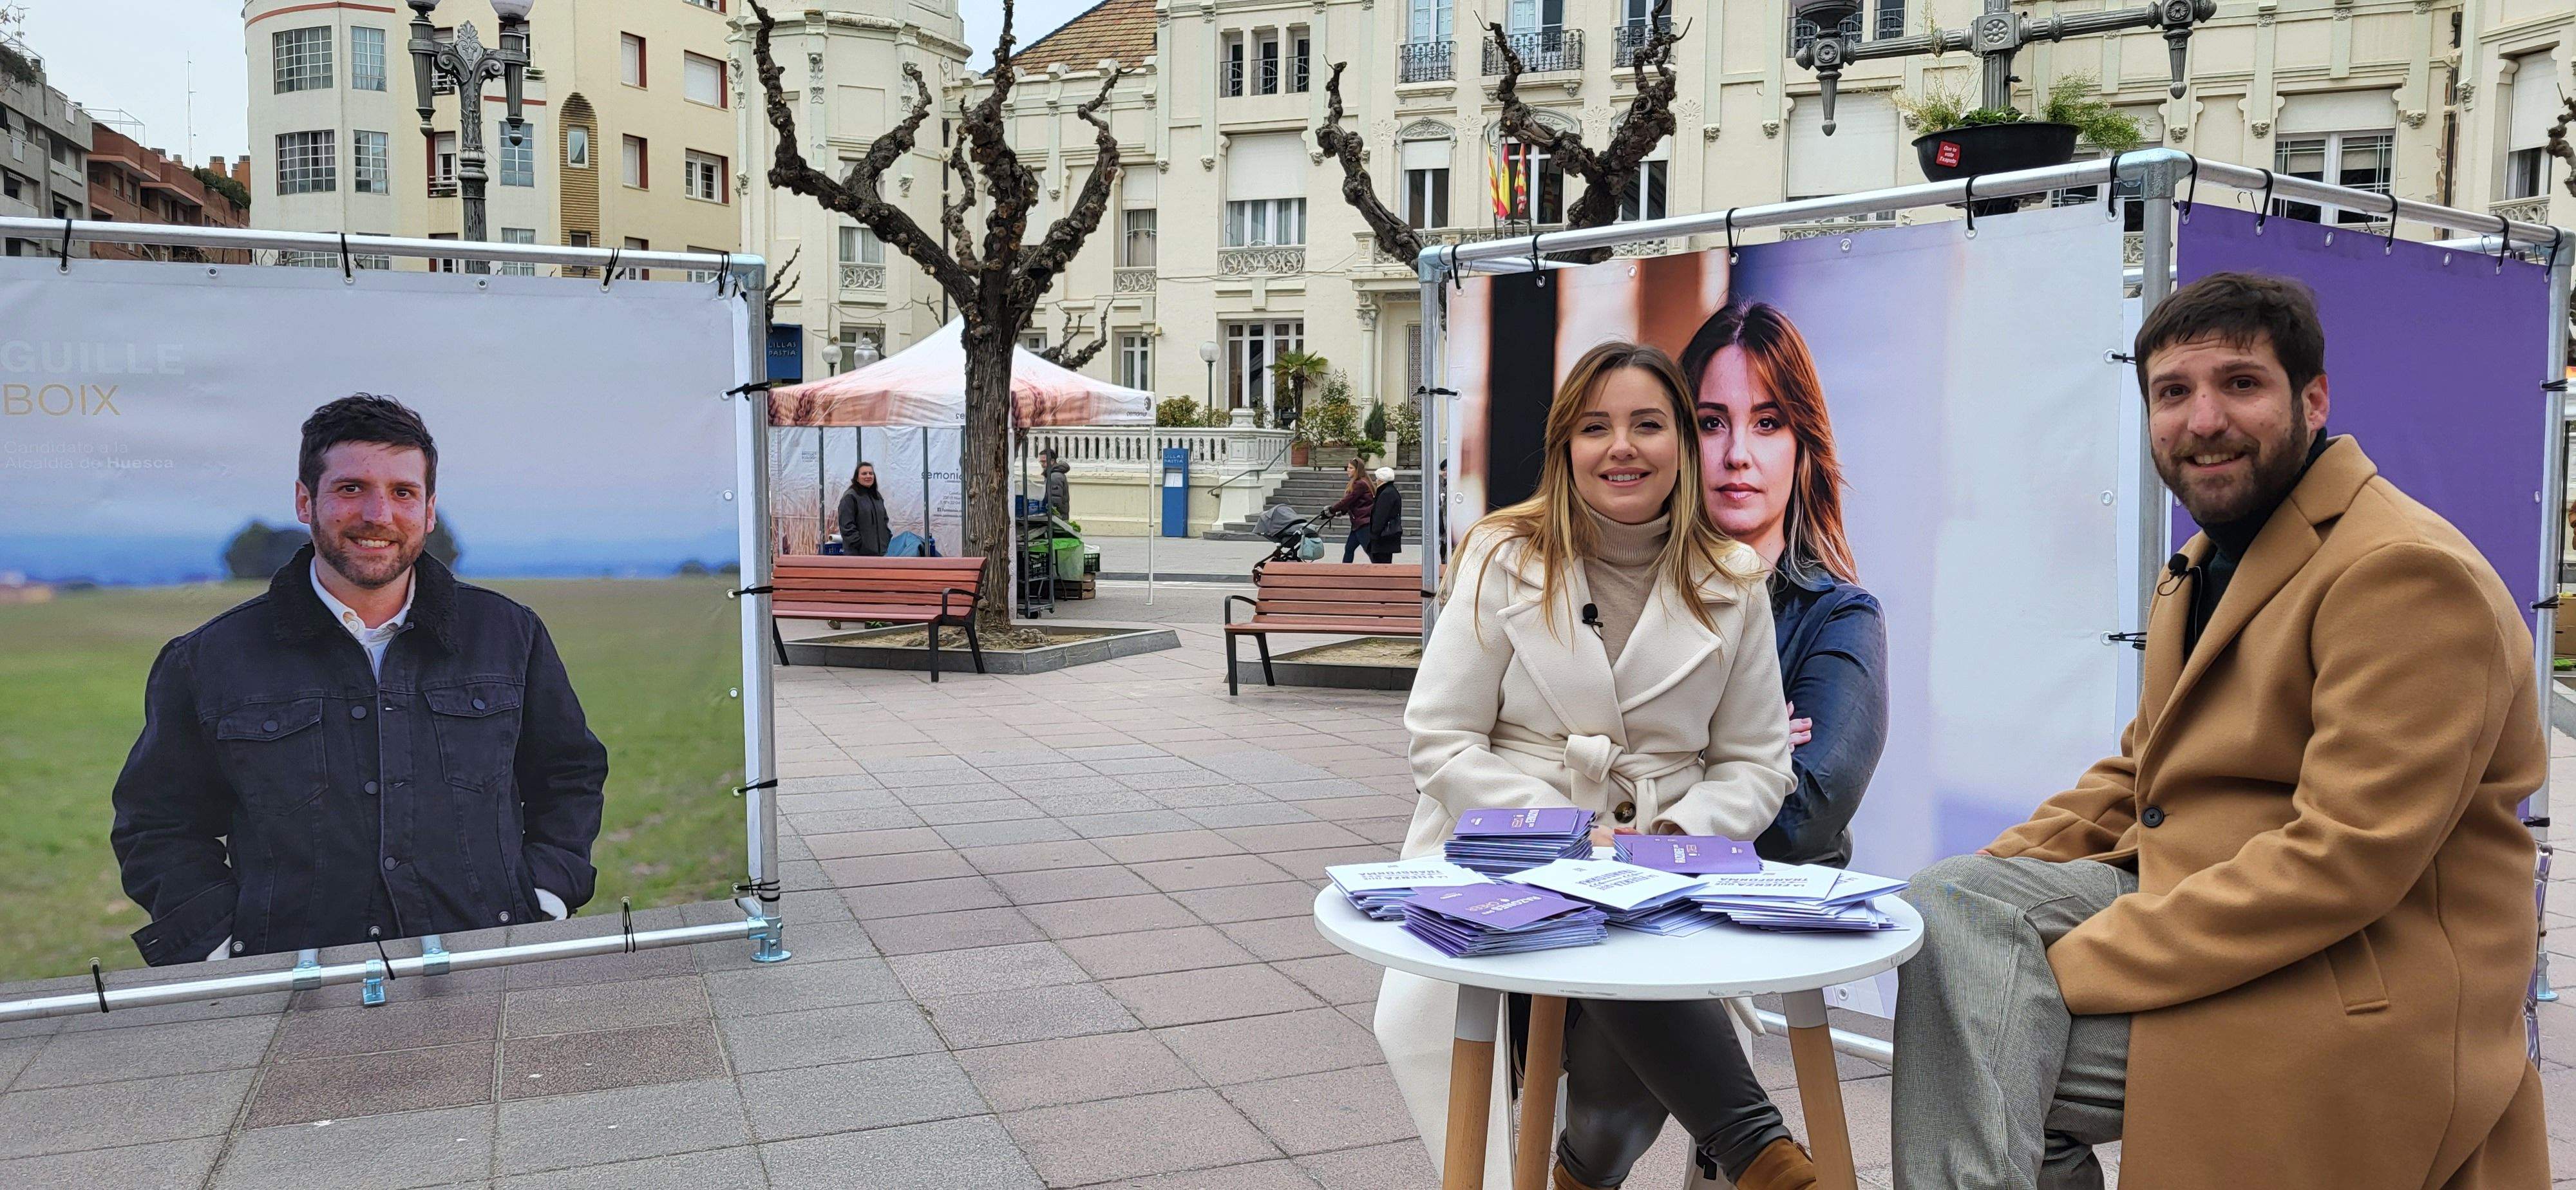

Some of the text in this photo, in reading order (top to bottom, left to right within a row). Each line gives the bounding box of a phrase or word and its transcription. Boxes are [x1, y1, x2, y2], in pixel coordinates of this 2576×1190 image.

[0, 340, 185, 375] GUILLE
[3, 383, 121, 417] BOIX
[4, 440, 129, 453] Candidato a la
[79, 457, 102, 469] de
[107, 457, 174, 469] Huesca
